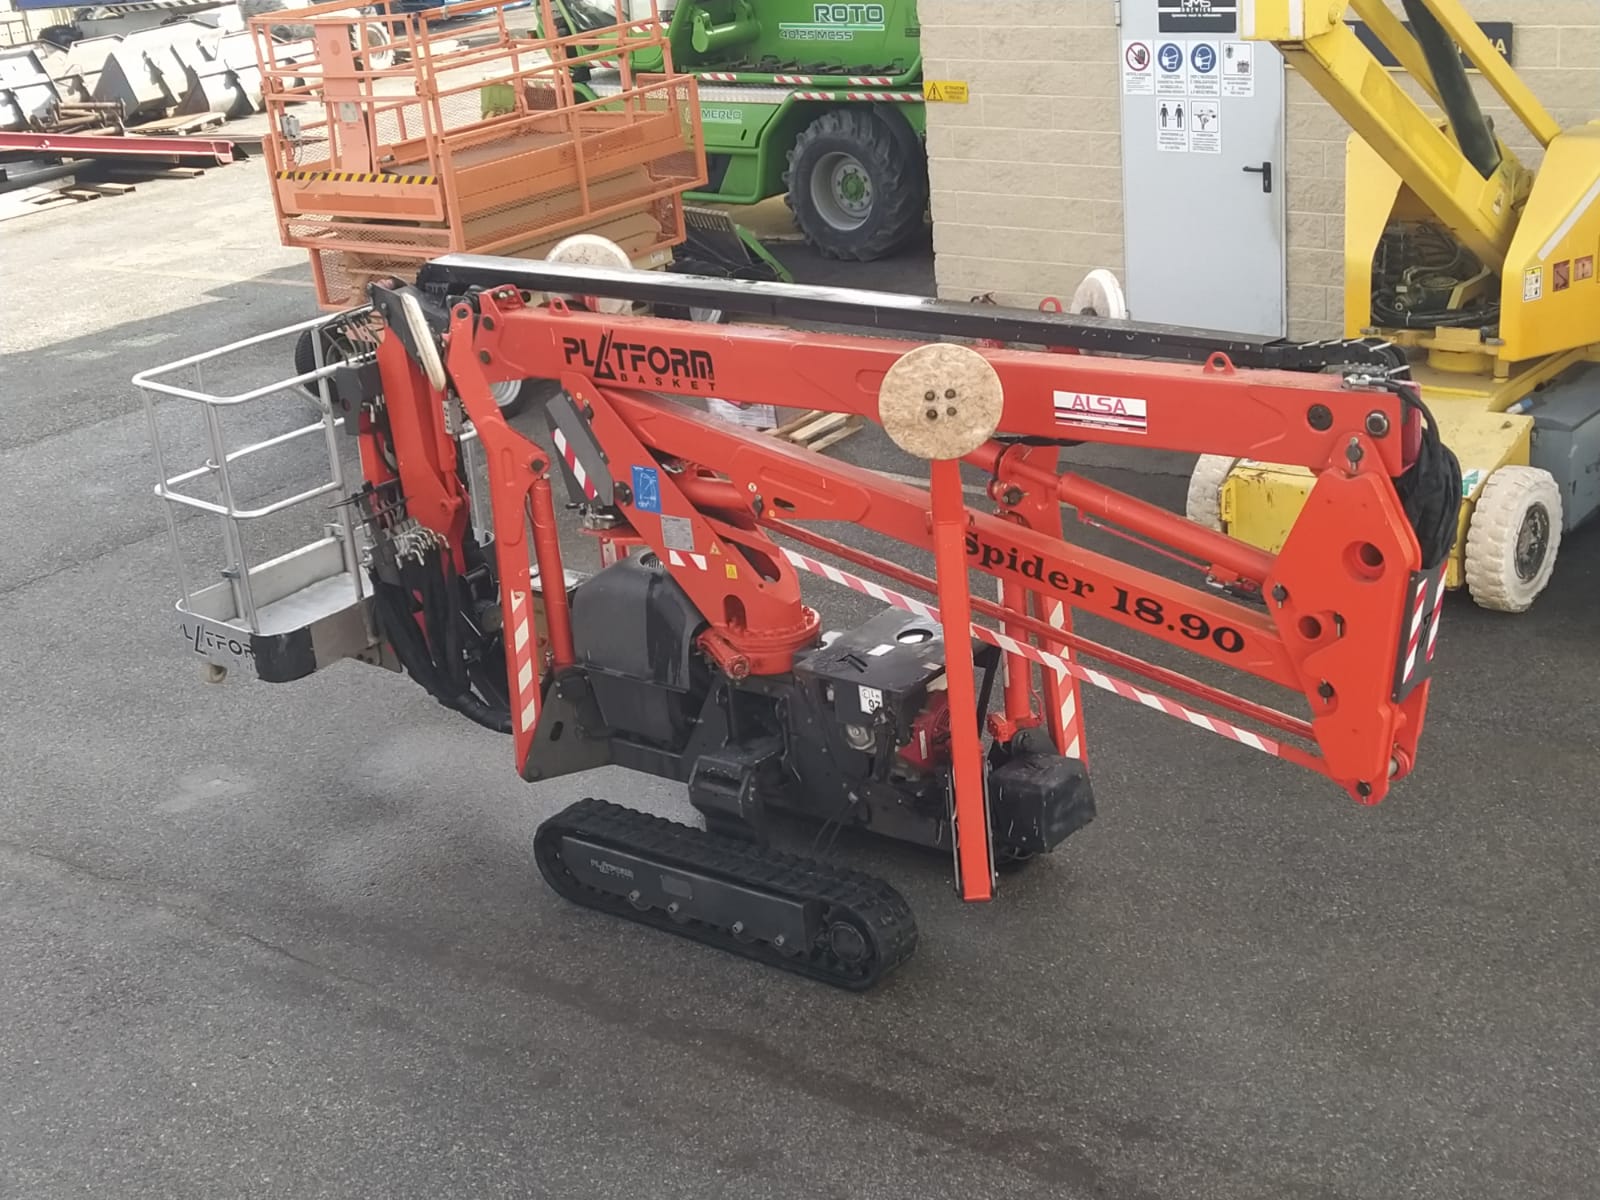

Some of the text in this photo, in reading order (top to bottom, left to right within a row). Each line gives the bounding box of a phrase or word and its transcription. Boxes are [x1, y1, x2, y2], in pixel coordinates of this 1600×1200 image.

[814, 4, 884, 23] ROTO
[702, 109, 742, 120] MERLO
[562, 330, 715, 380] PLATFORM
[620, 374, 716, 391] BASKET
[1071, 394, 1127, 415] ALSA
[965, 531, 1245, 654] Spider 18.90
